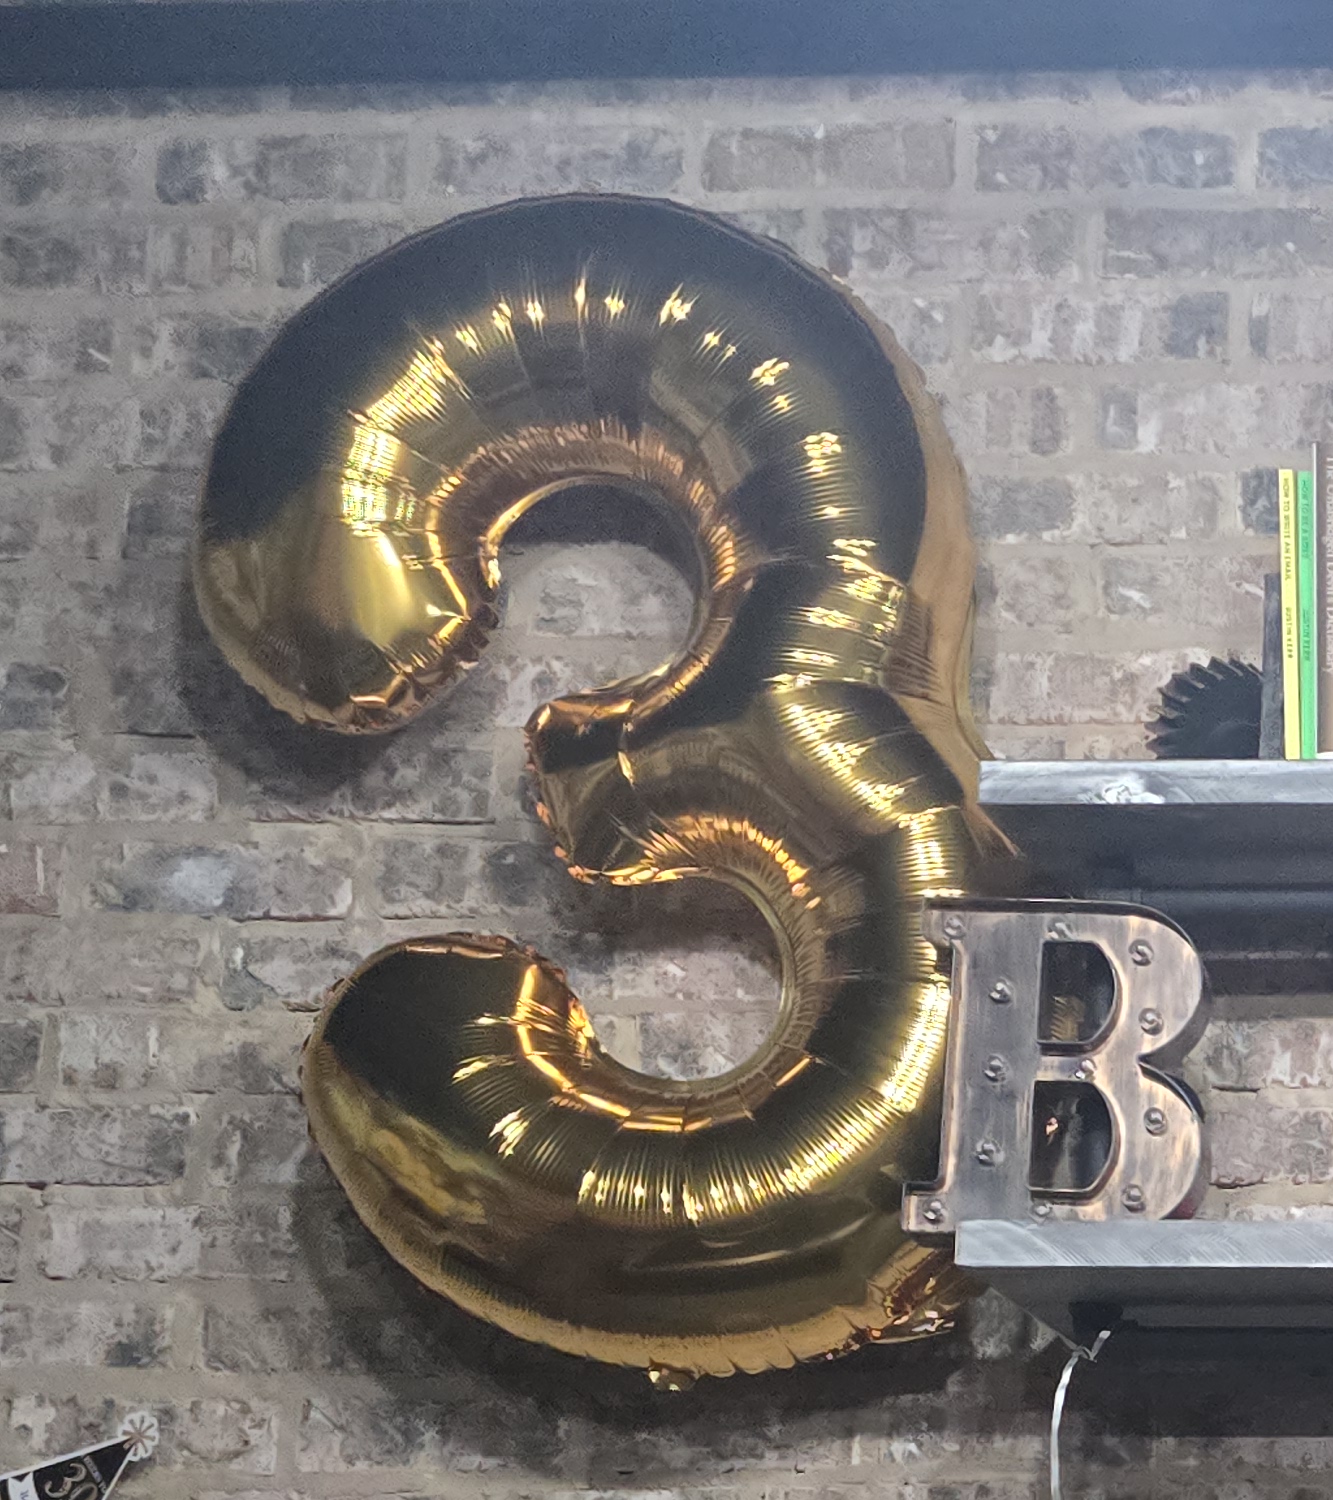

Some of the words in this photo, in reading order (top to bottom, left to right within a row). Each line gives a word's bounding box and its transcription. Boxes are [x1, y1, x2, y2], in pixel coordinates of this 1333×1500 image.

[1283, 500, 1291, 512] TO
[1284, 541, 1292, 554] AN
[1285, 556, 1293, 580] EMAIL
[902, 898, 1203, 1237] B
